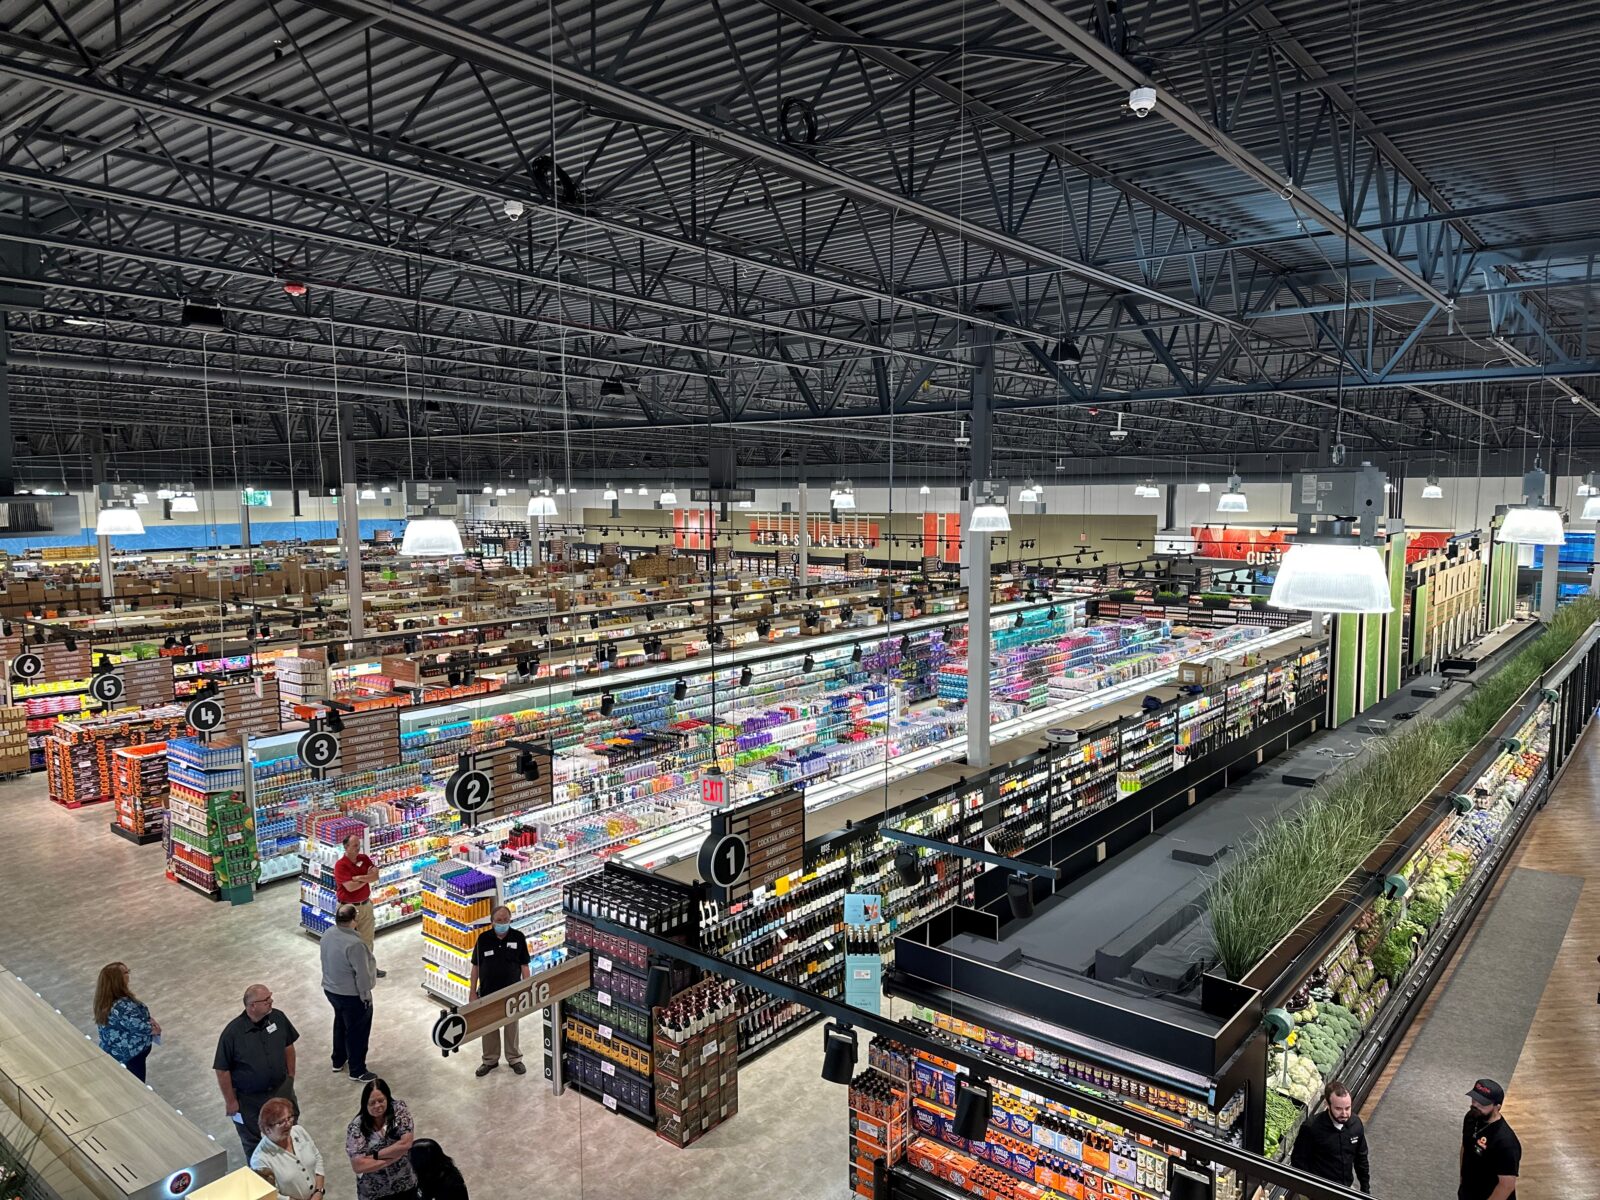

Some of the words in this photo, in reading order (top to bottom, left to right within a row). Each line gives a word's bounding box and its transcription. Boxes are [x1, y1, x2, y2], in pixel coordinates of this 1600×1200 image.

[821, 532, 865, 549] cuts
[23, 658, 35, 673] 6
[103, 680, 116, 697] 5
[200, 707, 214, 725] 4
[430, 719, 444, 727] baby
[445, 714, 458, 723] food
[369, 724, 381, 732] CARE
[349, 735, 370, 744] FEMININE
[371, 731, 390, 740] HYGIENE
[314, 739, 329, 761] 3
[356, 741, 384, 752] TOOTHPASTE
[356, 750, 385, 761] MOUTHWASH
[357, 760, 384, 769] DEODORANT
[467, 779, 481, 805] 2
[511, 781, 534, 791] VITAMINS
[703, 779, 724, 804] EXIT
[503, 795, 519, 803] COUGH
[530, 787, 542, 796] COLD
[503, 804, 519, 814] ADULT
[519, 798, 543, 809] NUTRITION
[770, 807, 782, 817] BEER
[770, 820, 782, 830] WINE
[757, 833, 778, 848] COCKTAIL
[779, 827, 796, 840] MIXERS
[766, 842, 788, 857] BARWARE
[726, 845, 736, 876] 1
[767, 855, 787, 869] PEANUTS
[763, 872, 778, 884] CRAFT
[779, 867, 790, 878] BEER
[505, 981, 550, 1018] cafe
